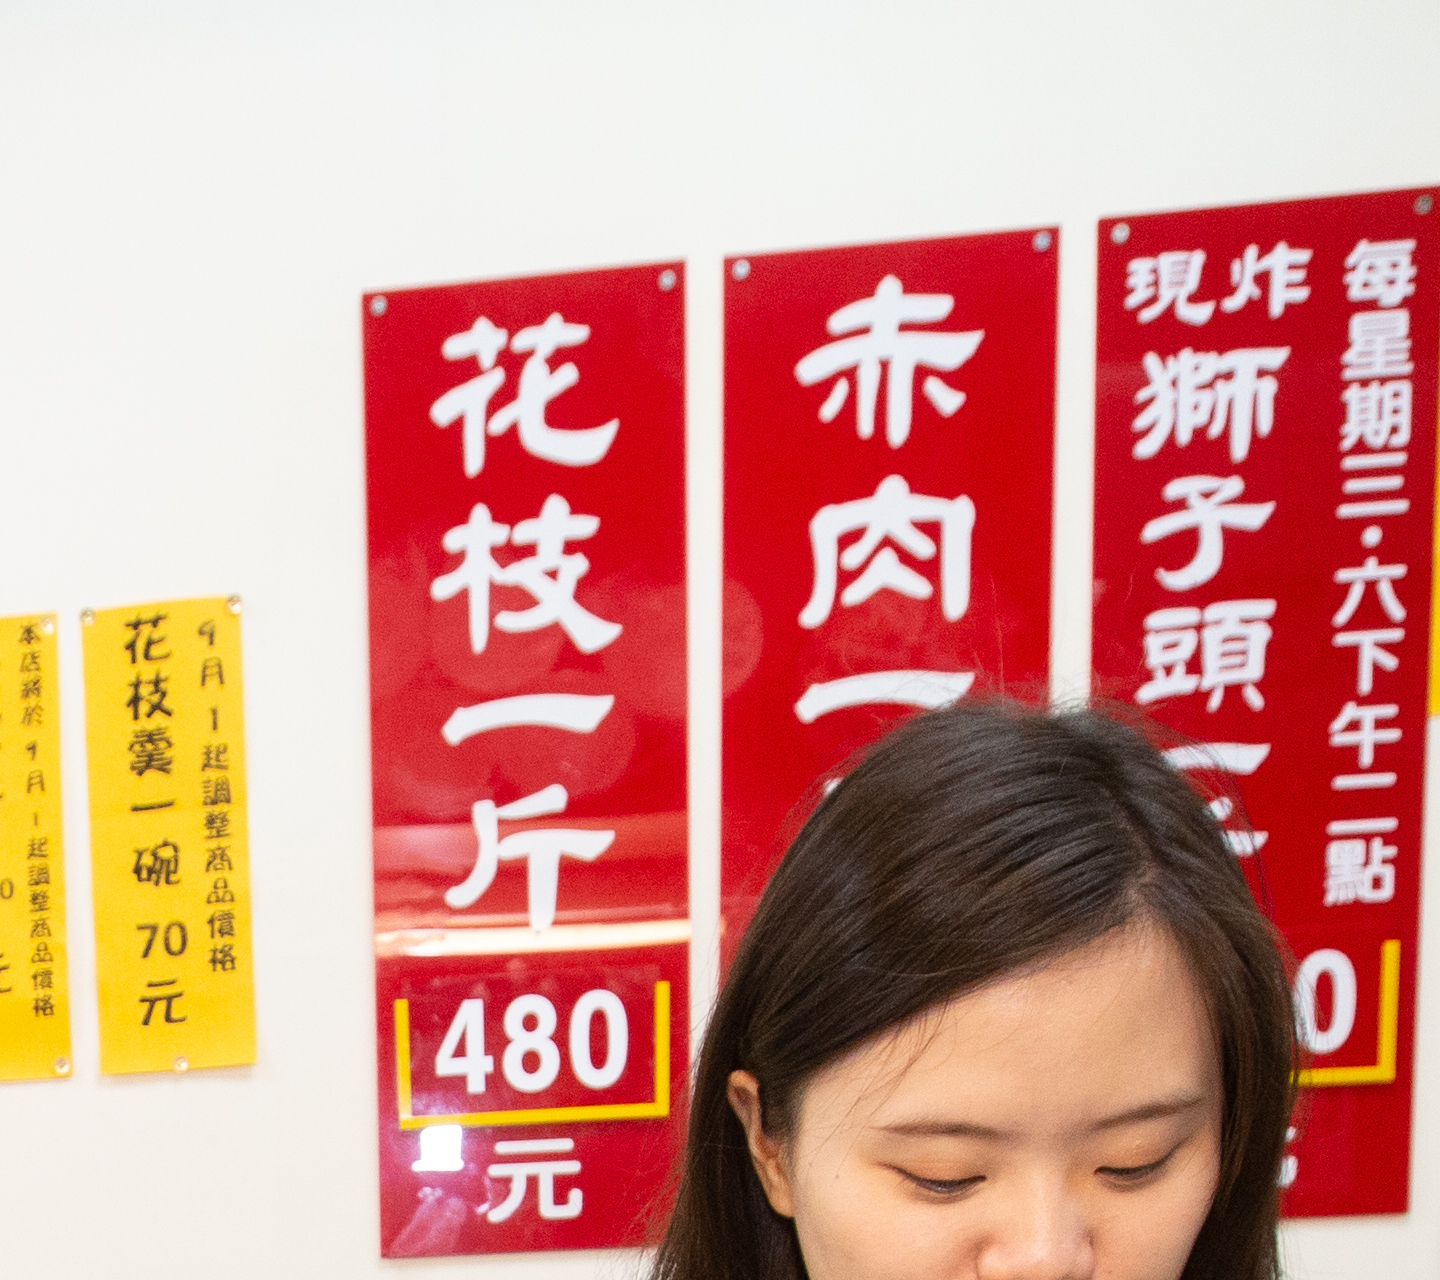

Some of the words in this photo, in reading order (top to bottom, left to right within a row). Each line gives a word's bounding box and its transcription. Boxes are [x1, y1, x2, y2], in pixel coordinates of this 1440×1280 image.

[1122, 239, 1313, 325] 現炸
[428, 310, 625, 933] 花枝一斤
[794, 273, 986, 797] 赤肉一
[1132, 345, 1294, 857] 獅子頭一
[432, 986, 631, 1096] 480
[485, 1136, 583, 1223] 元
